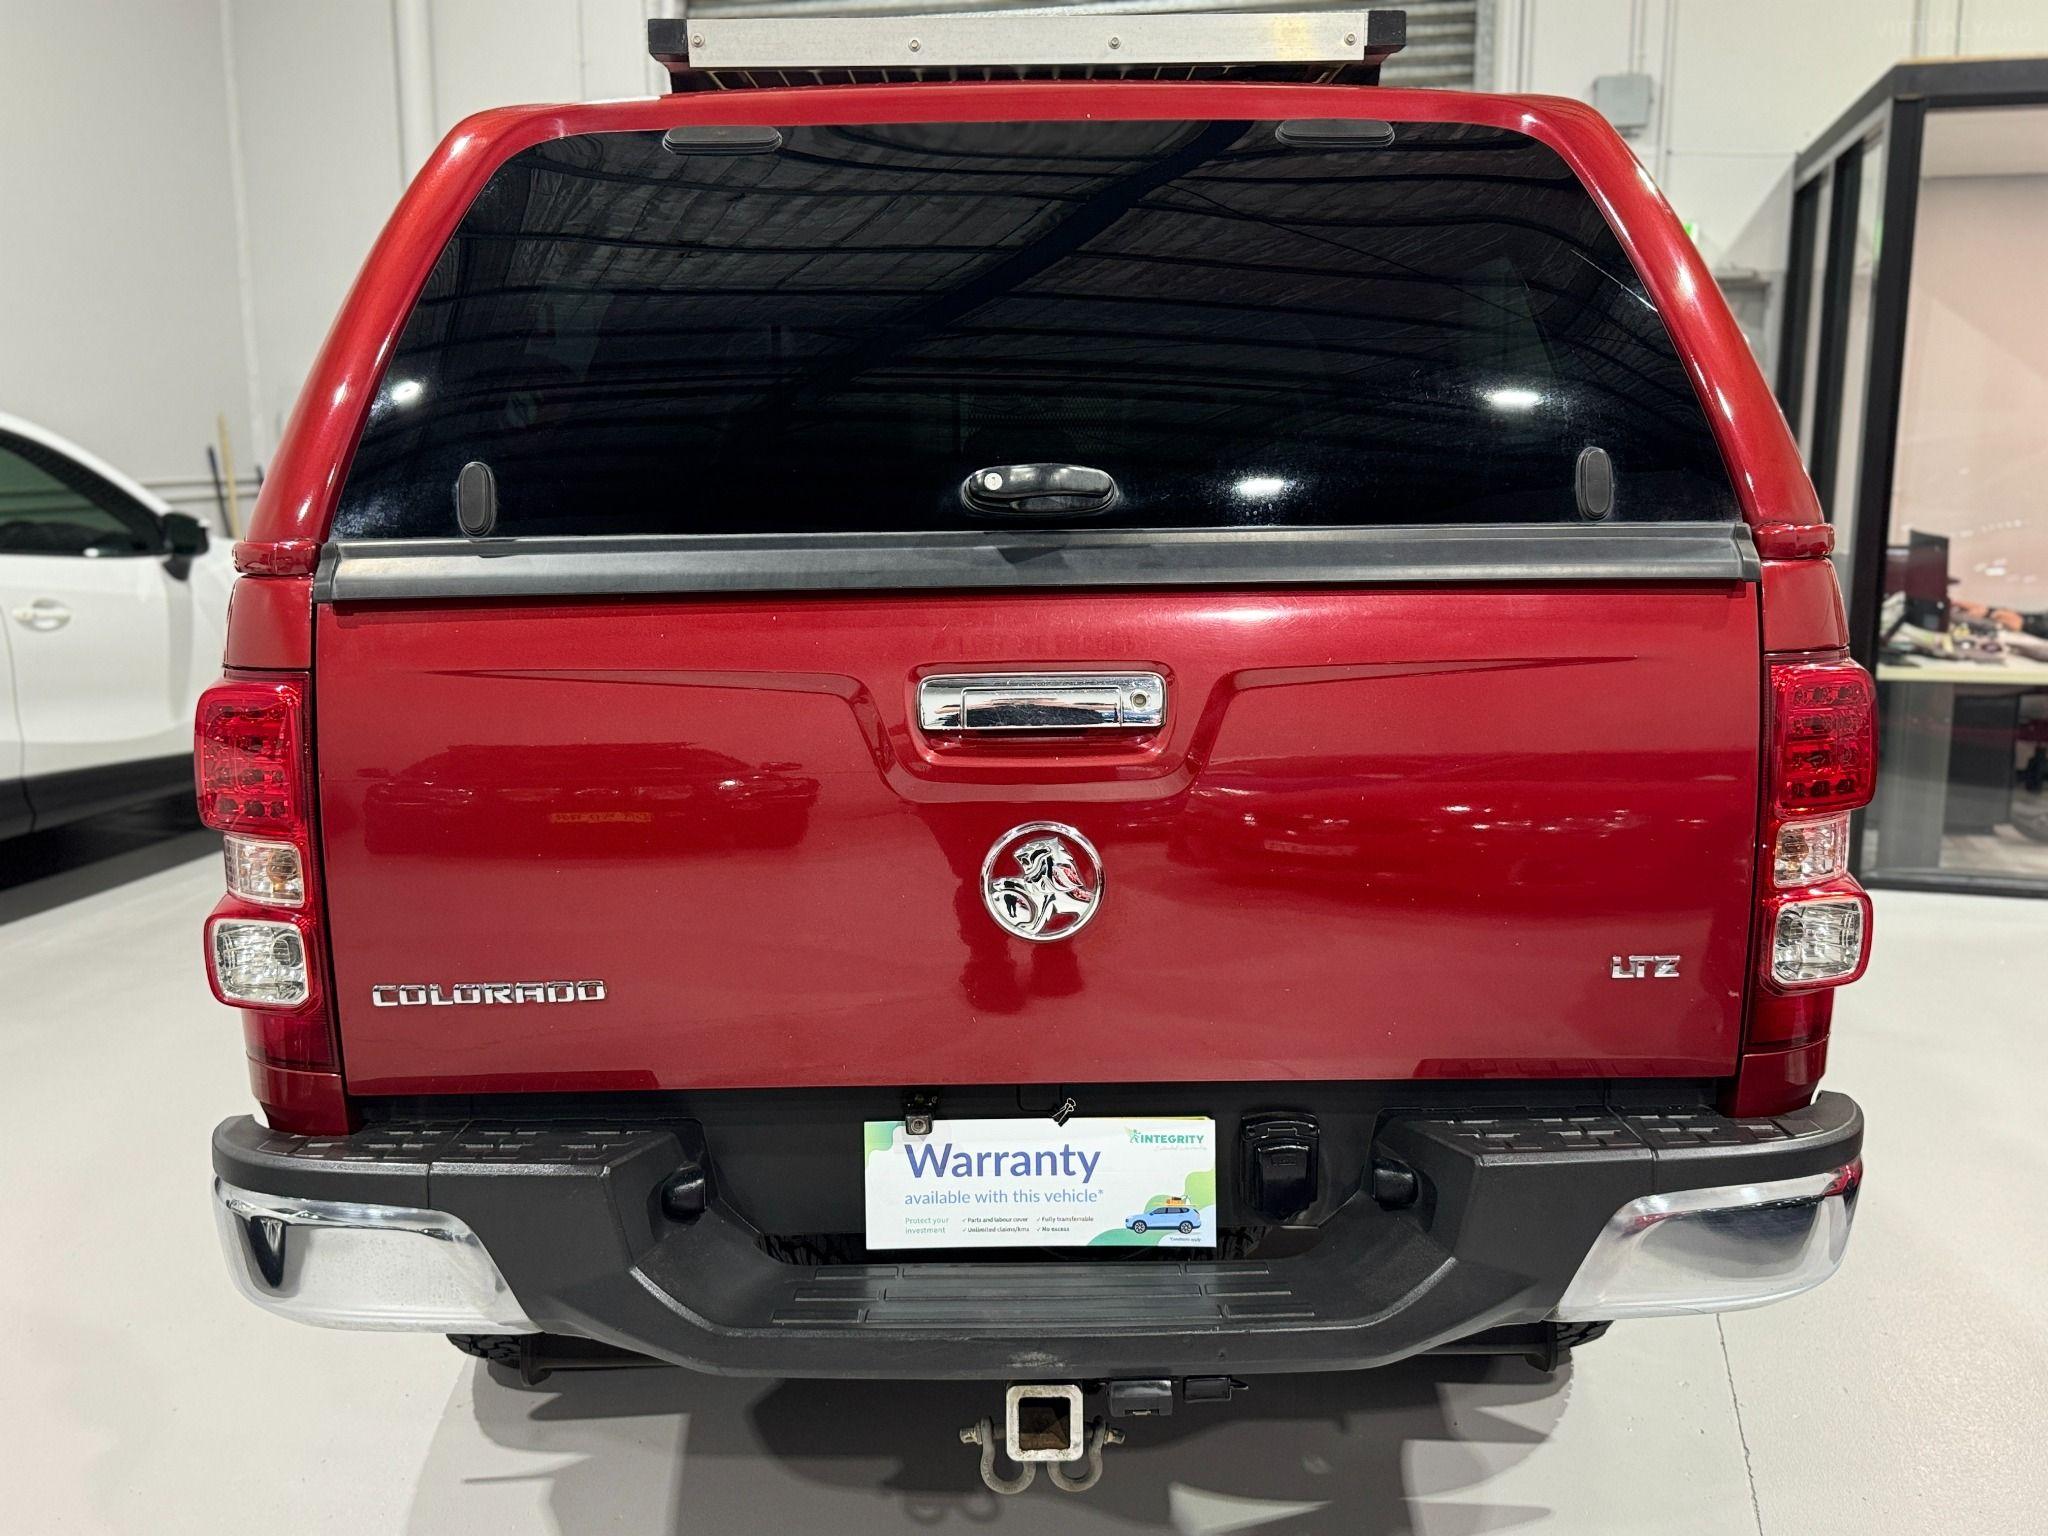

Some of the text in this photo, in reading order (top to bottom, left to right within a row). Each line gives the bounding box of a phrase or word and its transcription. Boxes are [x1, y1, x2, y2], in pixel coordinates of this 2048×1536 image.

[1611, 955, 1681, 978] LTZ
[372, 980, 607, 1007] COLORADO
[1141, 1134, 1205, 1144] INTEGRITY
[904, 1143, 1101, 1184] Warranty
[904, 1190, 971, 1205] available
[975, 1189, 1008, 1204] with
[1012, 1188, 1040, 1203] this
[905, 1217, 949, 1226] Protect your
[1041, 1216, 1056, 1224] Fully
[905, 1226, 946, 1234] investment
